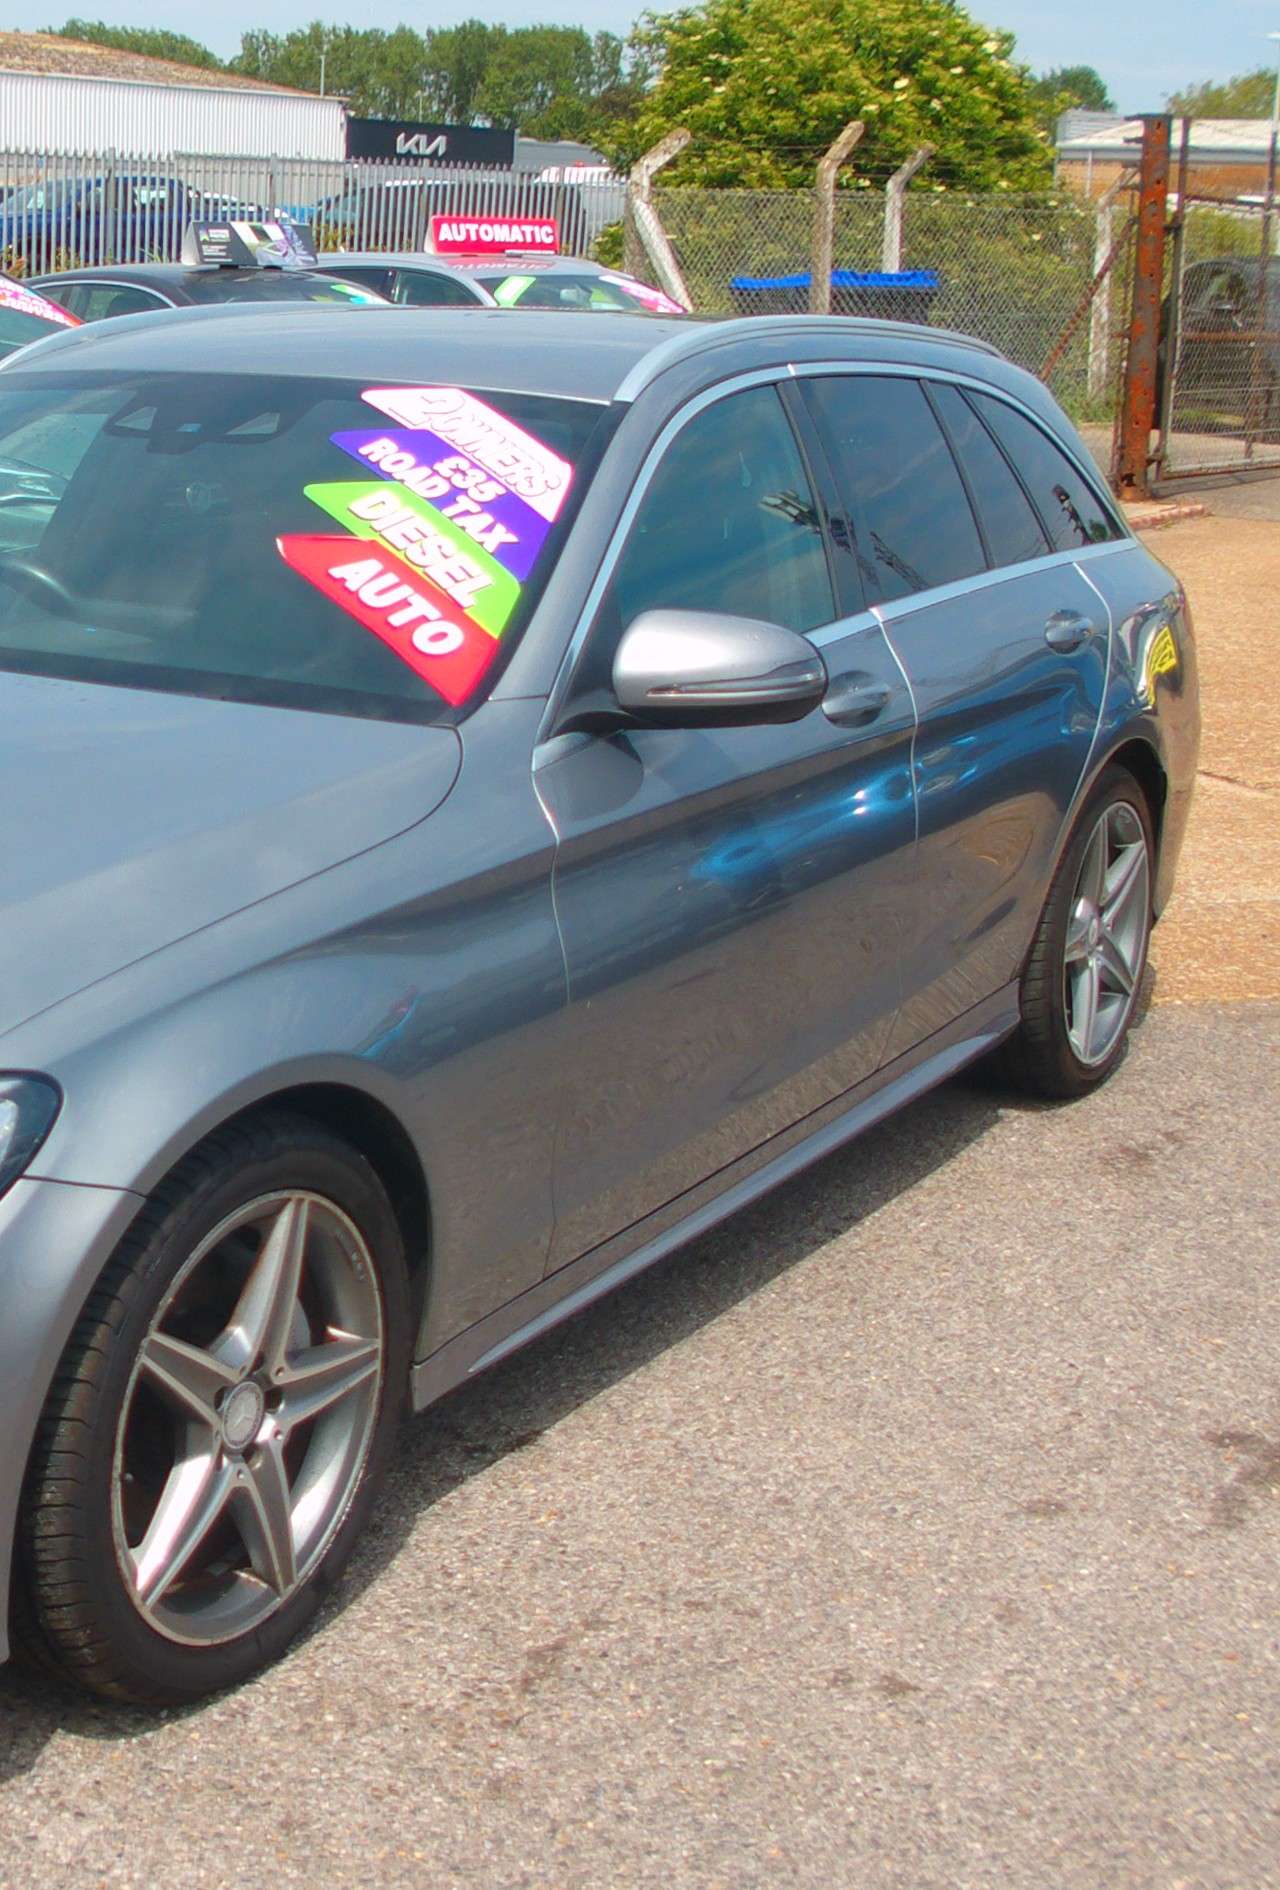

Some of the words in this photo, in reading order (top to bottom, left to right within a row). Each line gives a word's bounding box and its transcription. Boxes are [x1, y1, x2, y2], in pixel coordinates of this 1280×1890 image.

[396, 132, 447, 157] KIA
[438, 222, 554, 244] AUTOMATIC
[358, 437, 451, 498] ROAD
[441, 494, 520, 553] TAX
[428, 407, 562, 498] OWNERS
[432, 456, 508, 502] £35
[347, 489, 494, 609] DIESEL
[327, 558, 465, 655] AUTO
